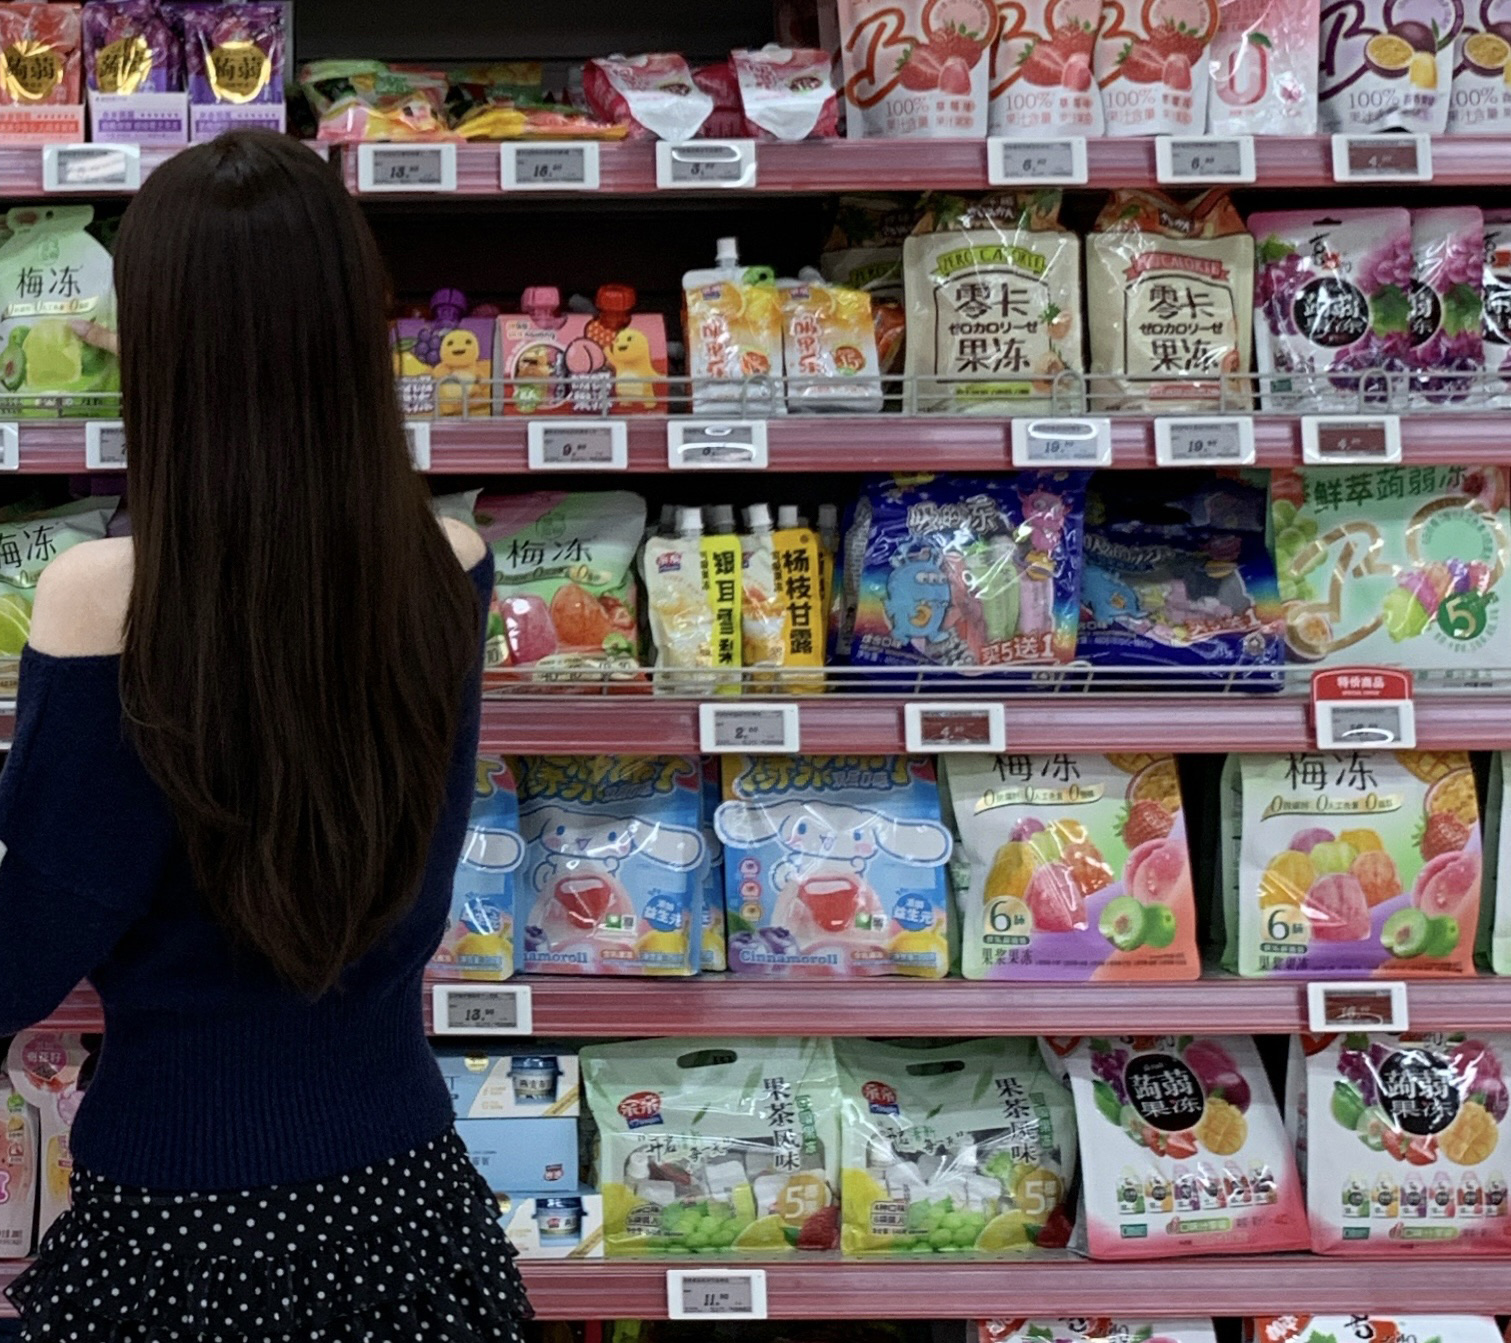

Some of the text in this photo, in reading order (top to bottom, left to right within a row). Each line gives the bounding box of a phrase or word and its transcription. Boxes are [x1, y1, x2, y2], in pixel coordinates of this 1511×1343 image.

[1006, 91, 1053, 109] 100%
[1108, 89, 1156, 106] 100%
[1349, 91, 1398, 108] 100%
[17, 266, 81, 298] 梅冻
[955, 283, 1031, 318] 零卡
[1149, 284, 1215, 318] 零卡
[956, 338, 1030, 372] 果冻
[1151, 338, 1224, 372] 果冻
[1311, 467, 1470, 513] 鲜萃蒟蒻冻
[506, 539, 593, 568] 梅冻
[788, 549, 813, 655] 杨枝甘露
[1337, 675, 1385, 689] 特价商品
[893, 908, 934, 925] 益生元
[1135, 1069, 1194, 1101] 蒟蒻
[1386, 1068, 1450, 1101] 蒟蒻
[762, 1076, 802, 1171] 果茶风味
[995, 1076, 1038, 1164] 果茶风味
[1140, 1098, 1203, 1118] 果冻
[1391, 1099, 1454, 1119] 果冻
